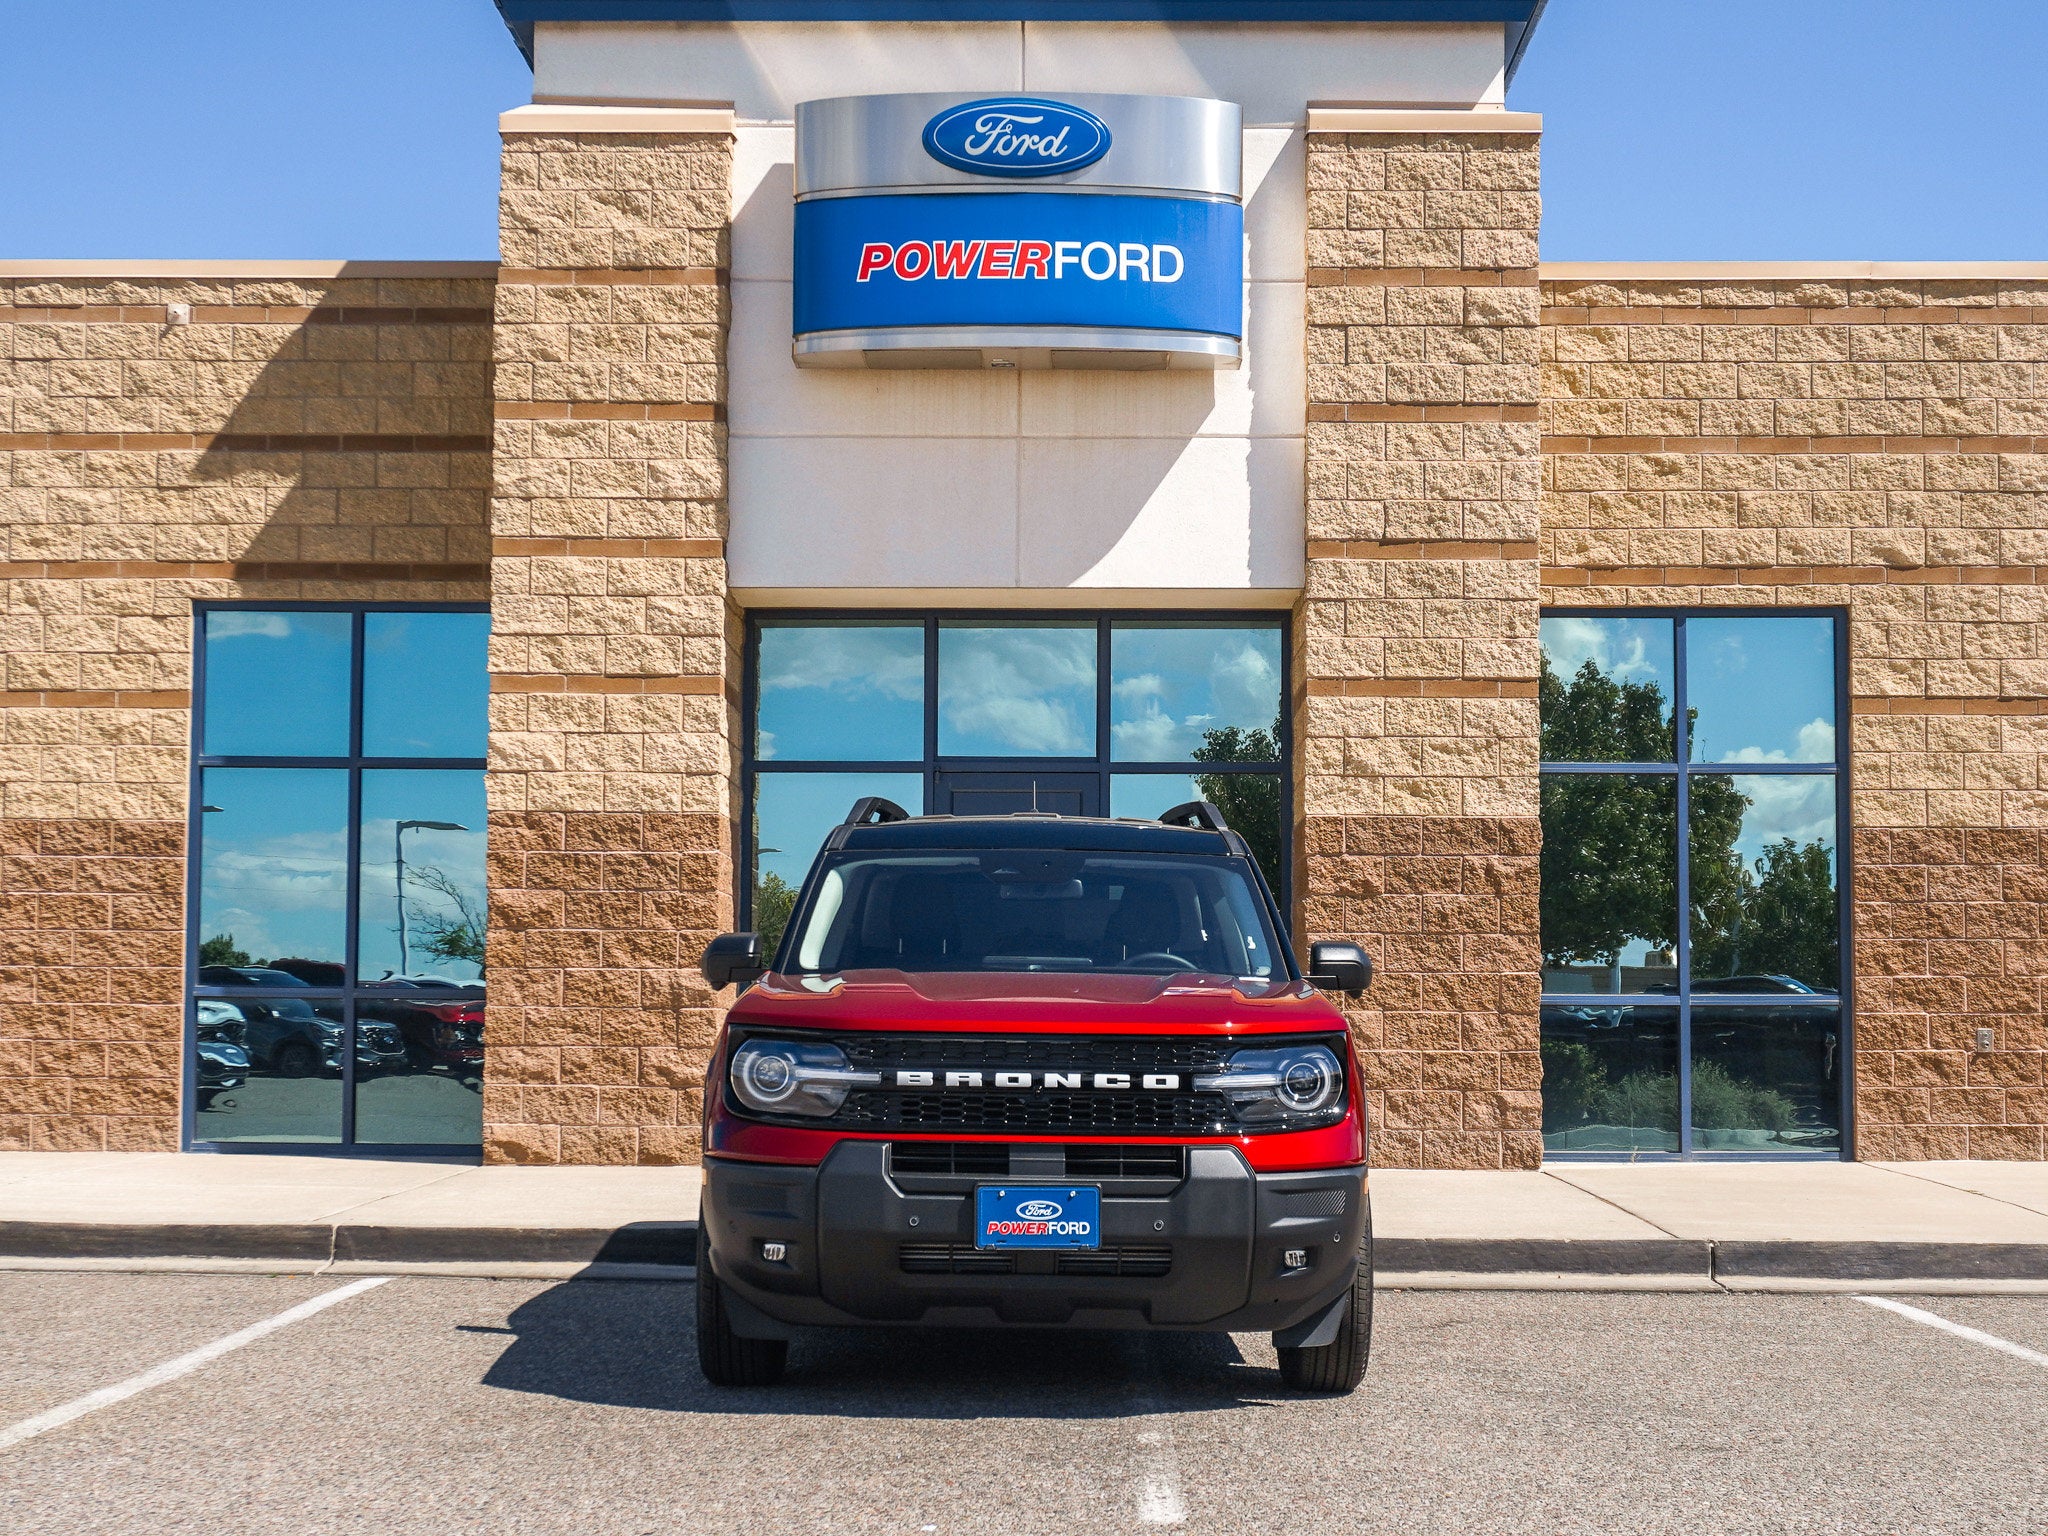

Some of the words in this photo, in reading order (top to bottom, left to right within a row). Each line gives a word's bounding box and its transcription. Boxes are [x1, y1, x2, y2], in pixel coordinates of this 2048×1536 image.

[964, 112, 1070, 159] Ford
[896, 1071, 1180, 1090] BRONCO
[1025, 1203, 1053, 1216] Ford
